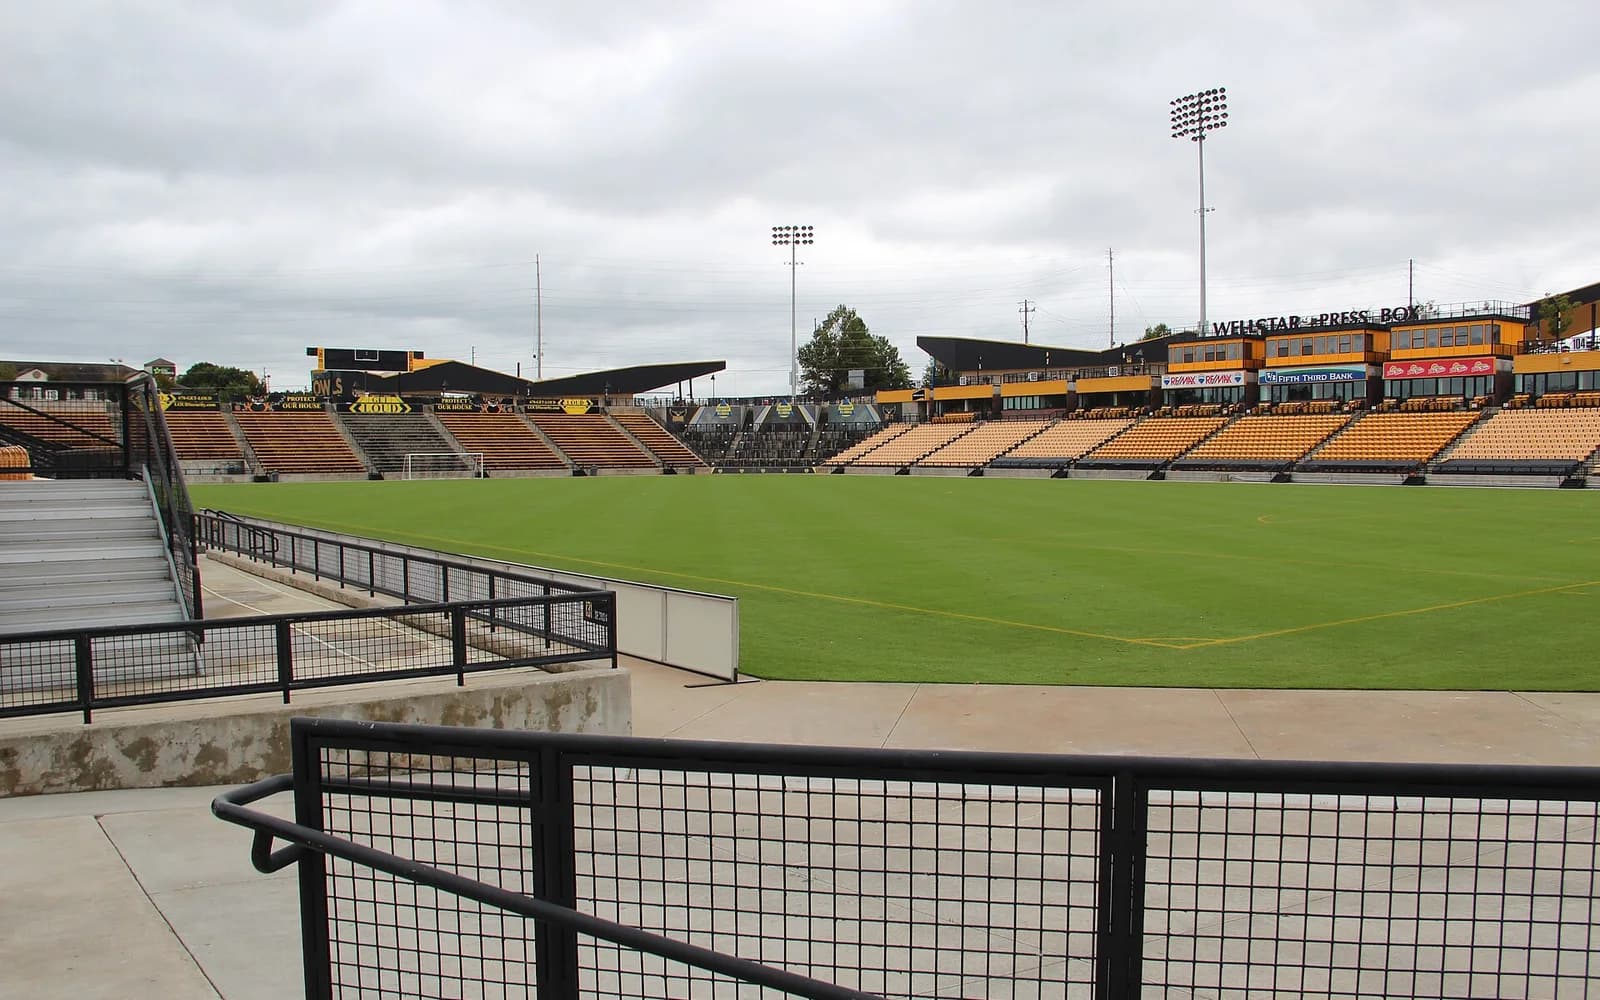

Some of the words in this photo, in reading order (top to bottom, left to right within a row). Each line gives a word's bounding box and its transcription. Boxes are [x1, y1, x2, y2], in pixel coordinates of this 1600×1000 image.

[1213, 315, 1300, 337] WELLSTAR
[1319, 310, 1368, 327] PRESS
[1380, 305, 1419, 322] BOX
[1170, 375, 1196, 386] RE/MAX
[1205, 373, 1232, 385] RE/MAX
[1278, 375, 1300, 383] FIFTH
[1303, 374, 1328, 382] THIRD
[1329, 372, 1353, 380] BANK
